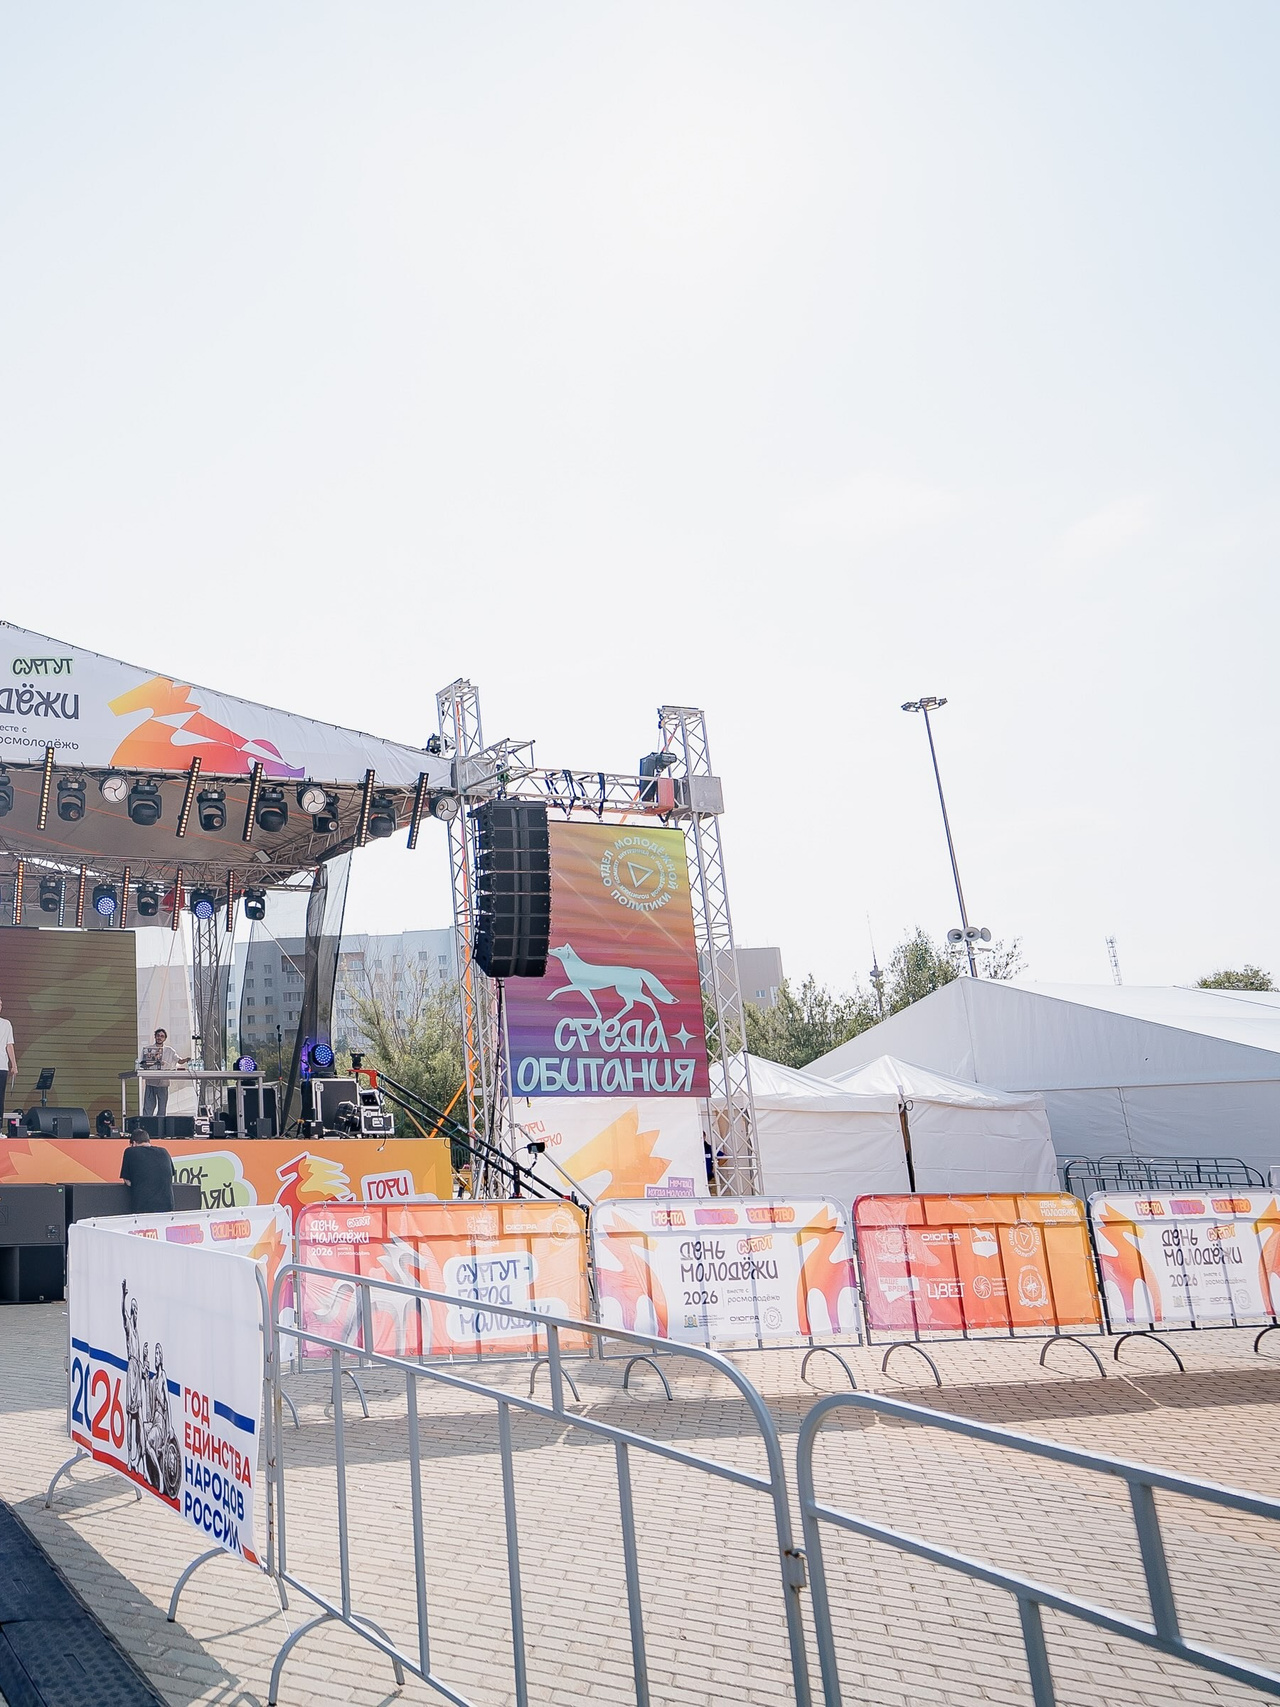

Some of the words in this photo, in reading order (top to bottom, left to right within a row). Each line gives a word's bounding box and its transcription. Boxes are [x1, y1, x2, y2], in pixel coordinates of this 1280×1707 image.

[12, 658, 73, 675] СУРГУТ
[600, 850, 614, 886] ОТДЕЛ
[610, 889, 671, 911] ПОЛИТИКИ
[517, 1056, 696, 1092] ОБИТАНИЯ
[367, 1176, 409, 1200] ГОРИ
[683, 1290, 718, 1306] 2026
[1169, 1274, 1198, 1287] 2026
[184, 1386, 210, 1429] ГОД
[184, 1421, 252, 1489] ЕДИНСТВА
[184, 1455, 245, 1522] НАРОДОВ
[184, 1490, 241, 1555] РОССИИ
